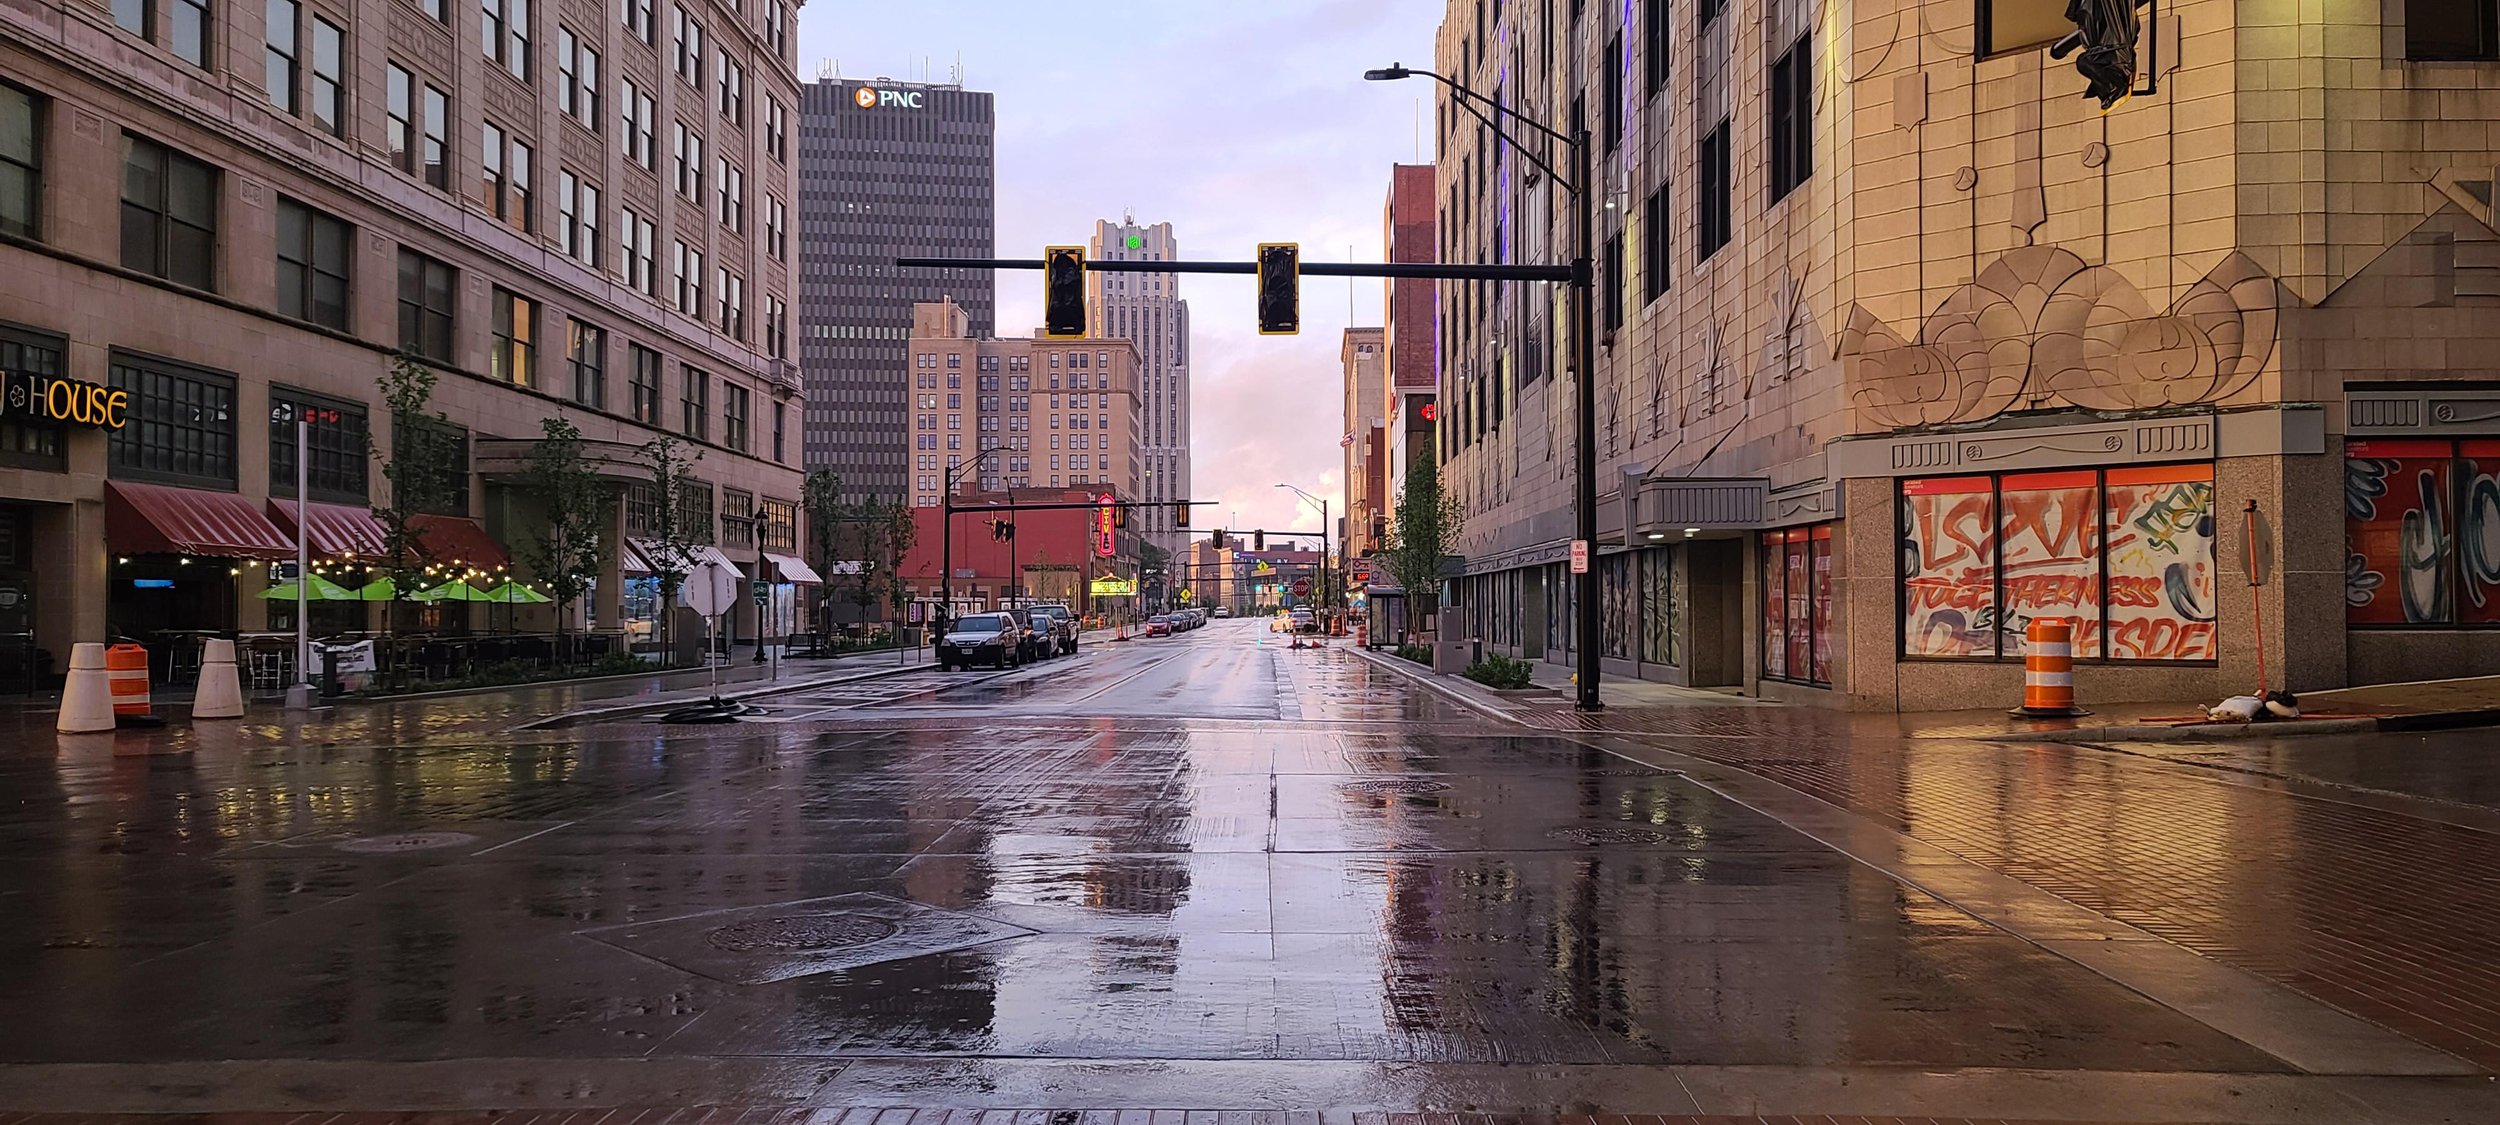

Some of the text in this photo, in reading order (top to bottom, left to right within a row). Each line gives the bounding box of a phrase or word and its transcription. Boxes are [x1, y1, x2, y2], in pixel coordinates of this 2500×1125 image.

[879, 90, 922, 108] PNC
[28, 375, 128, 429] HOUSE
[1912, 490, 2138, 571] LOVE
[1294, 585, 1309, 593] STOP
[1904, 575, 2161, 616] TOGETHERNESS
